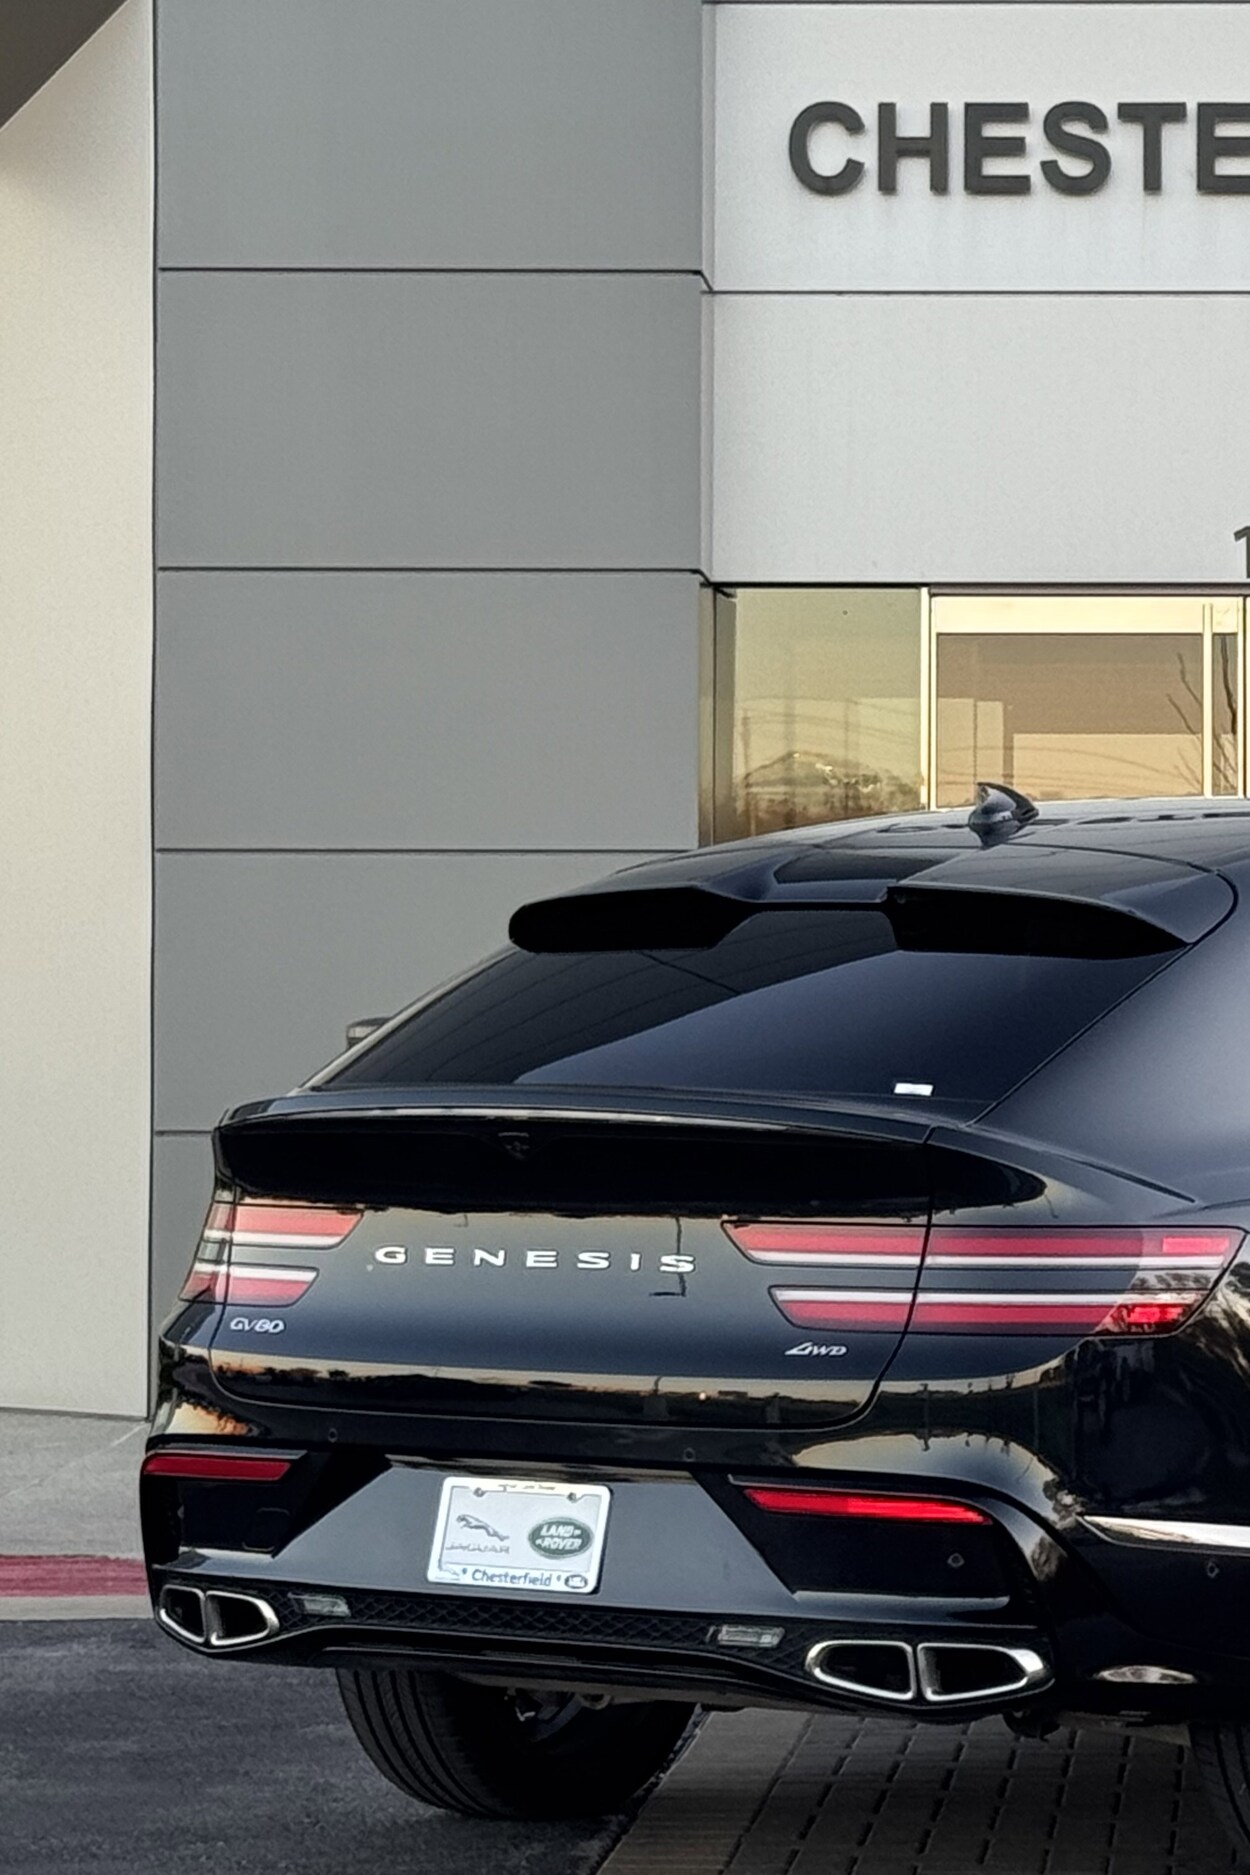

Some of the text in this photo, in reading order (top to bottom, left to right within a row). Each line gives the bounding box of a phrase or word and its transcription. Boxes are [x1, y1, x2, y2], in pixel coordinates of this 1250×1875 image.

[374, 1245, 695, 1273] GENESIS
[230, 1317, 285, 1333] GV80
[784, 1341, 847, 1356] 4WD
[471, 1568, 552, 1587] Chesterfield
